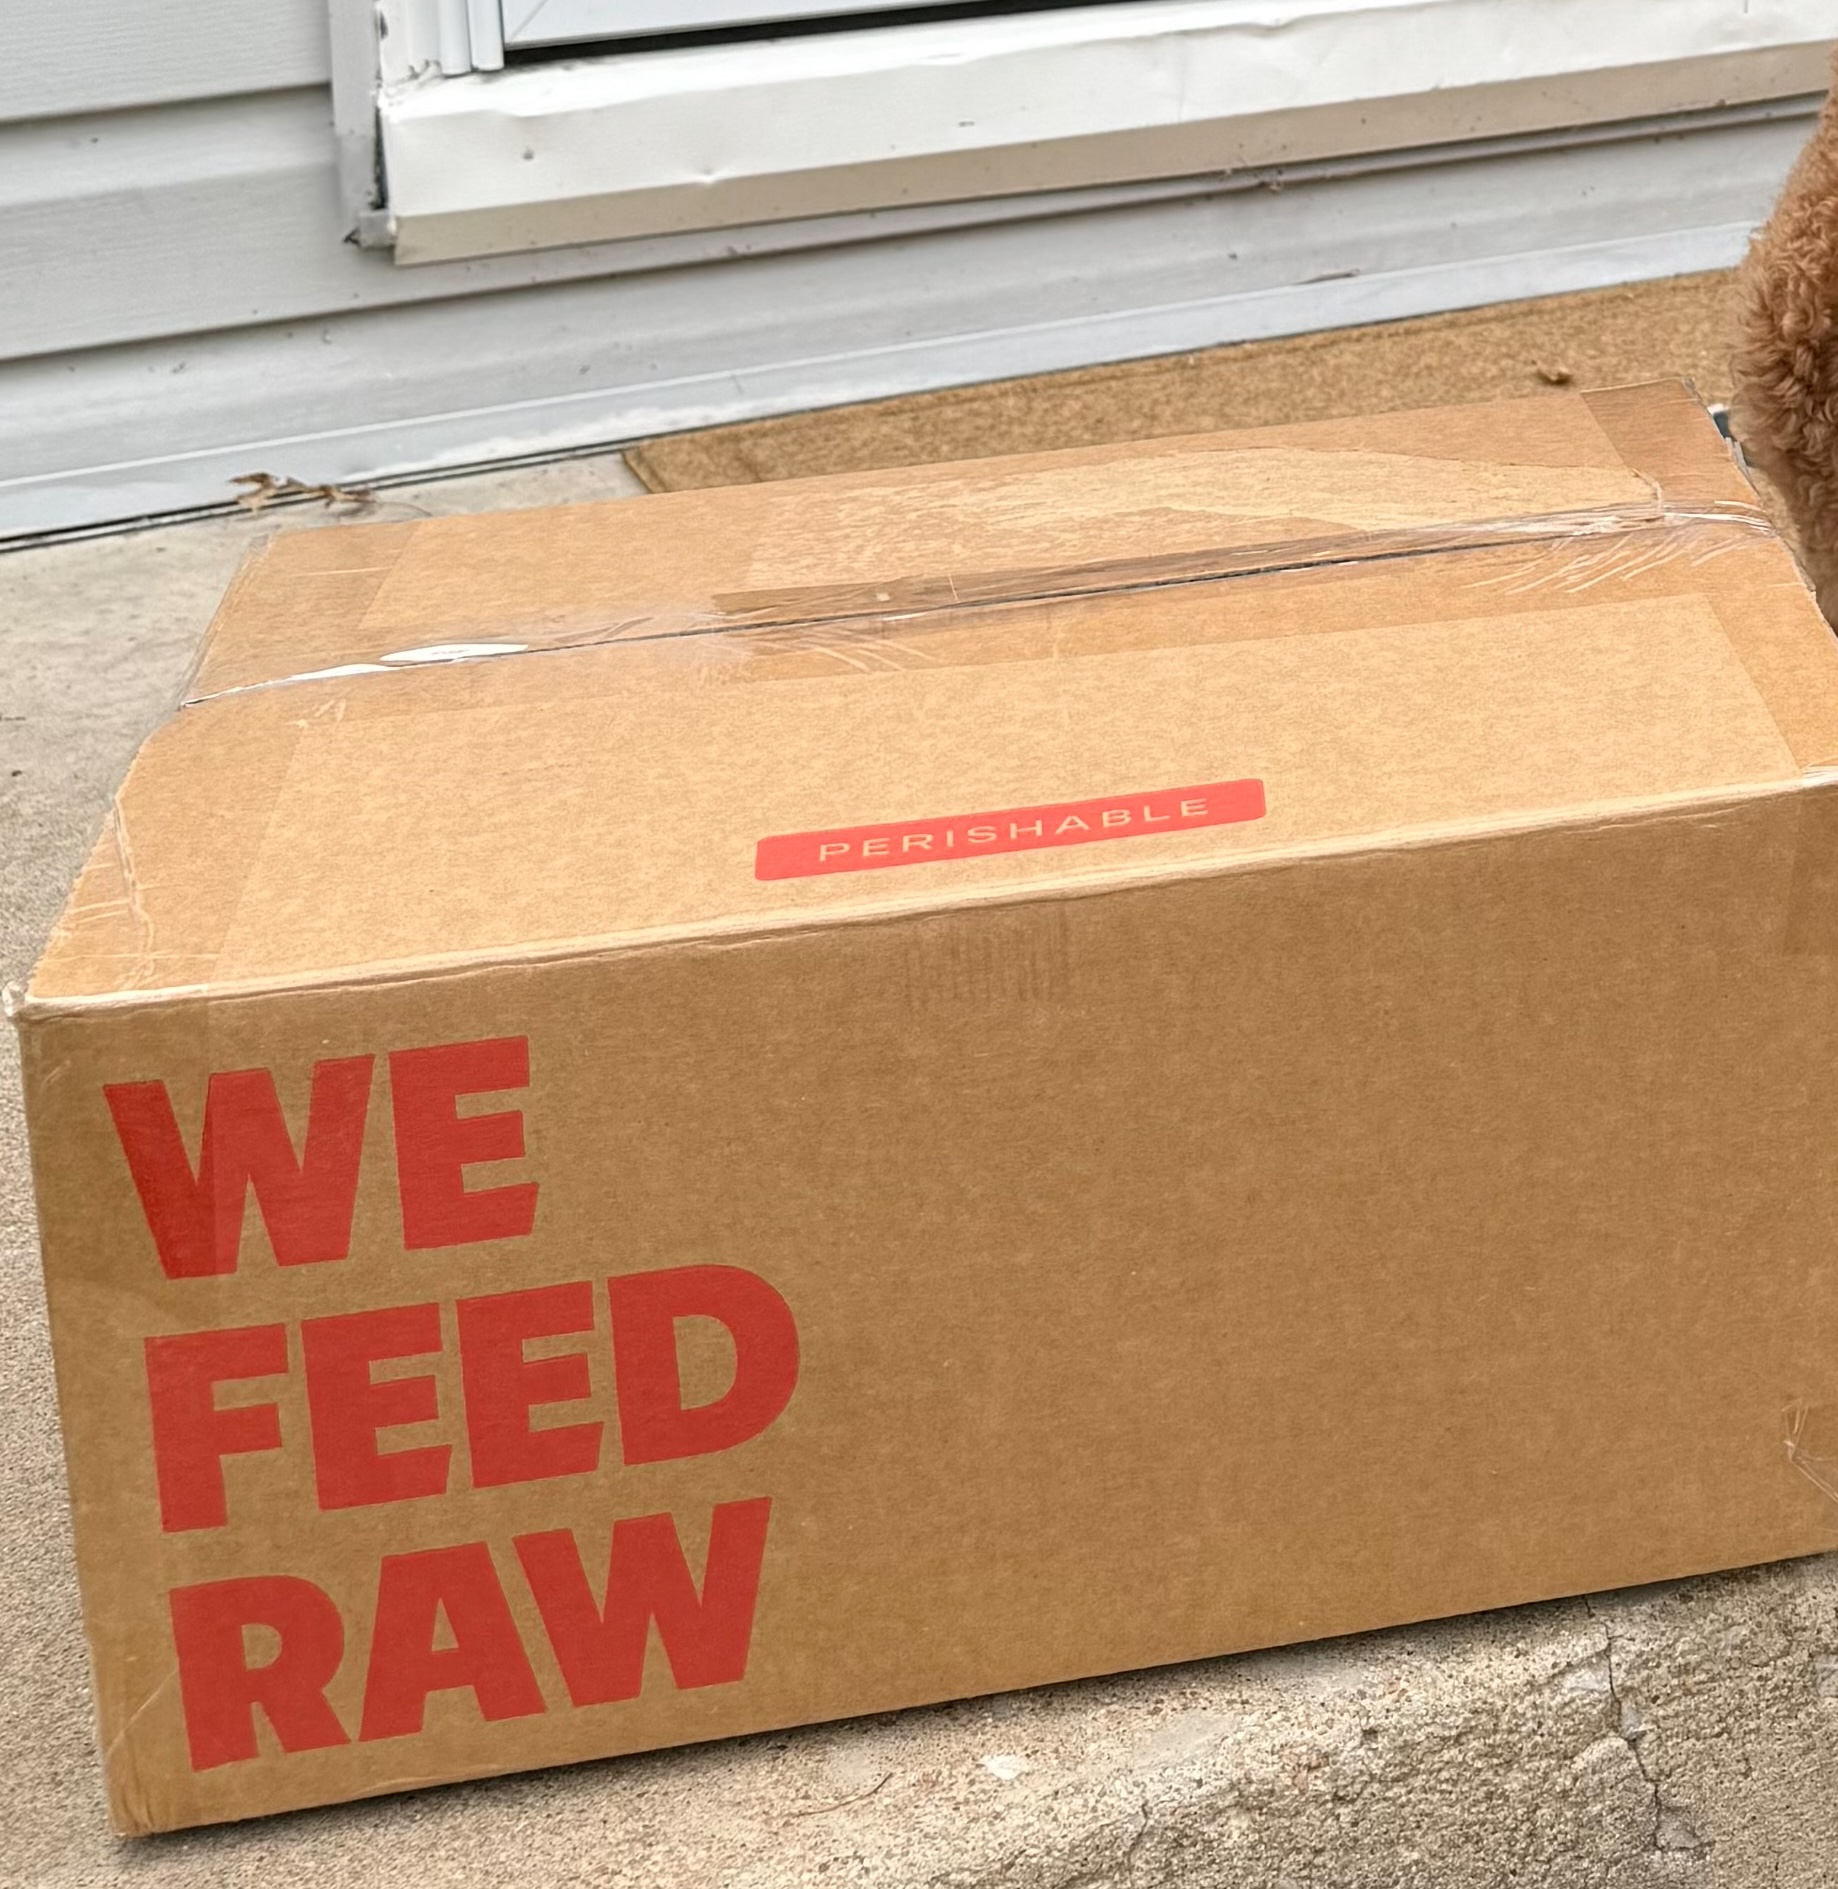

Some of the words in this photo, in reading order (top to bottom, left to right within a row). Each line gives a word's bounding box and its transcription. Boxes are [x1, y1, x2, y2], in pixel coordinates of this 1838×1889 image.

[818, 797, 1210, 862] PERISHABLE
[102, 1035, 540, 1280] WE
[143, 1264, 801, 1533] FEED
[168, 1496, 774, 1773] RAW
